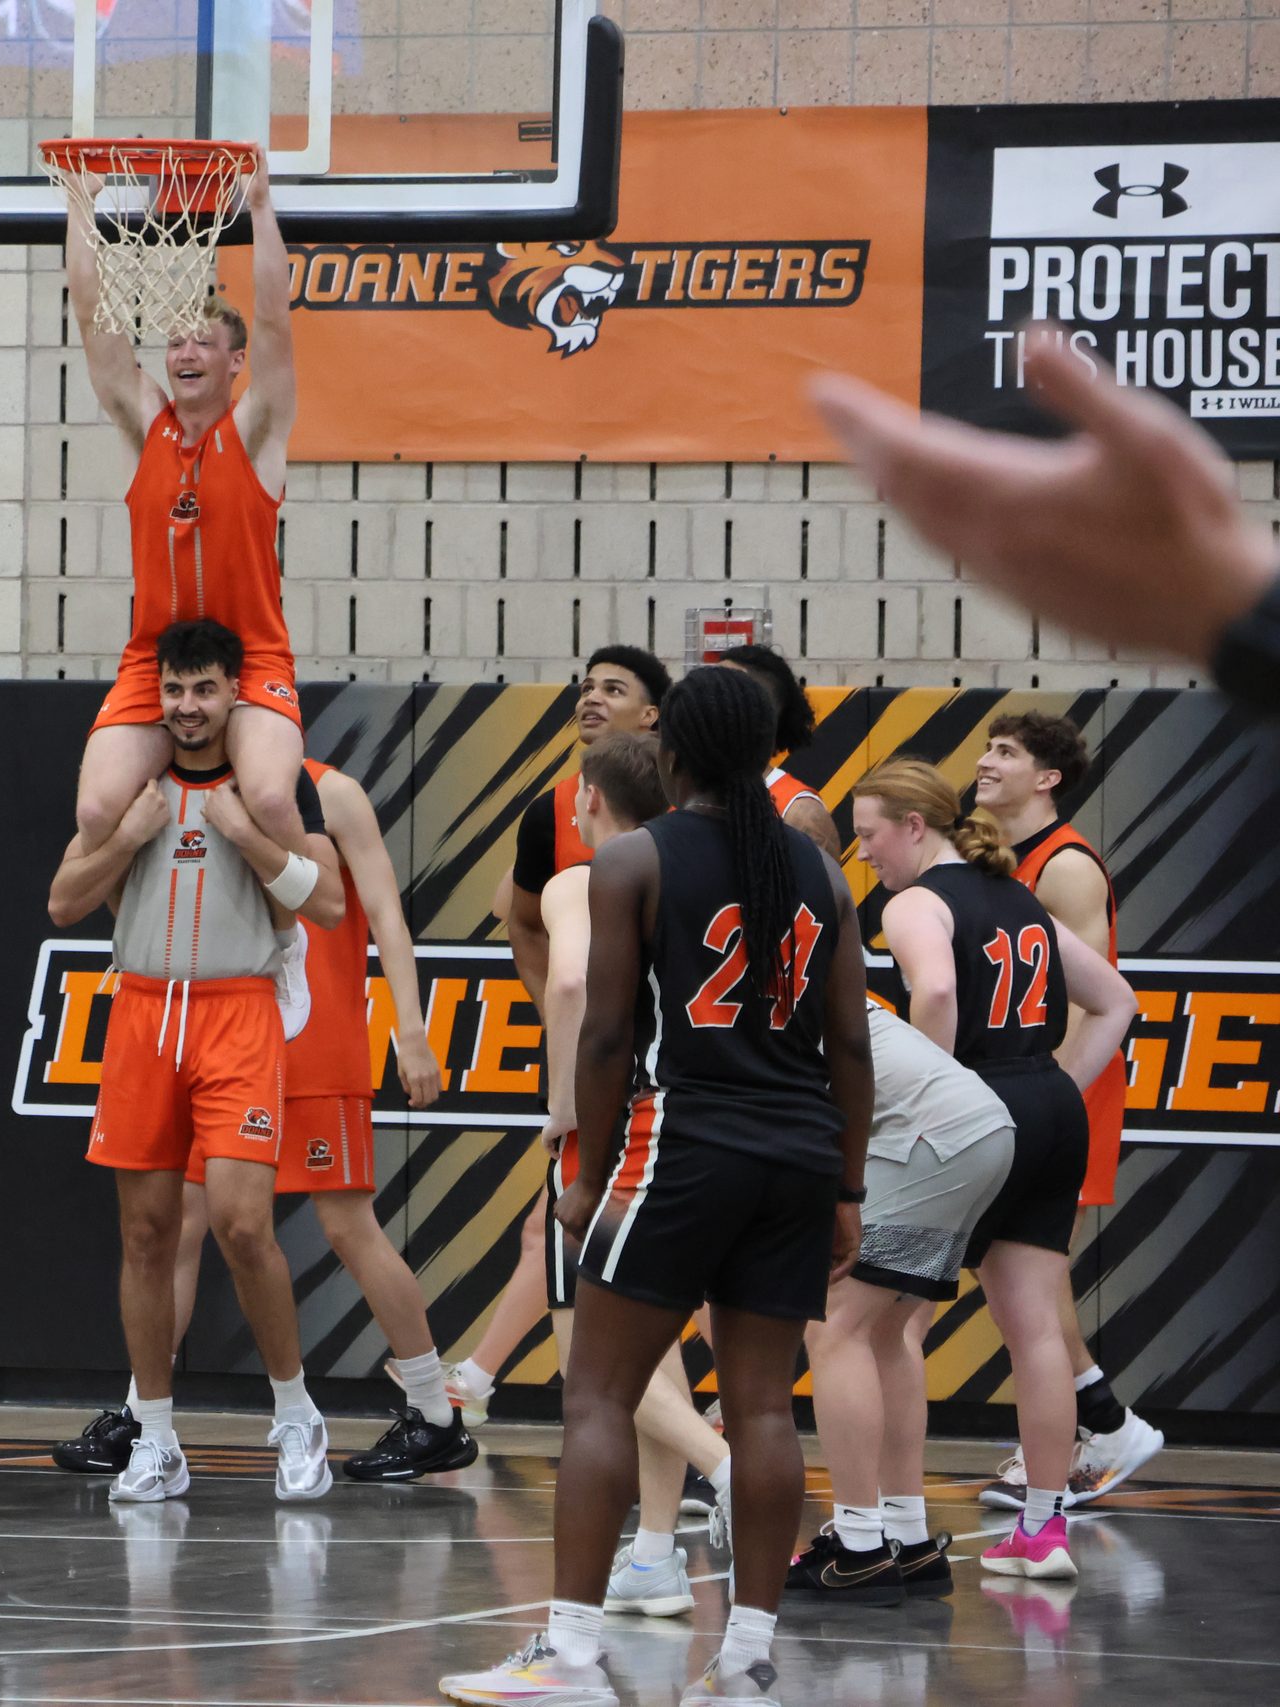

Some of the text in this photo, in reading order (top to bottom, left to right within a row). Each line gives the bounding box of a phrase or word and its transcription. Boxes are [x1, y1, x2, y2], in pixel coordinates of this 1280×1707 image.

[630, 247, 861, 302] TIGERS
[987, 241, 1280, 322] PROTECT
[1230, 397, 1236, 409] I
[983, 924, 1050, 1029] 12
[43, 971, 543, 1094] DNE
